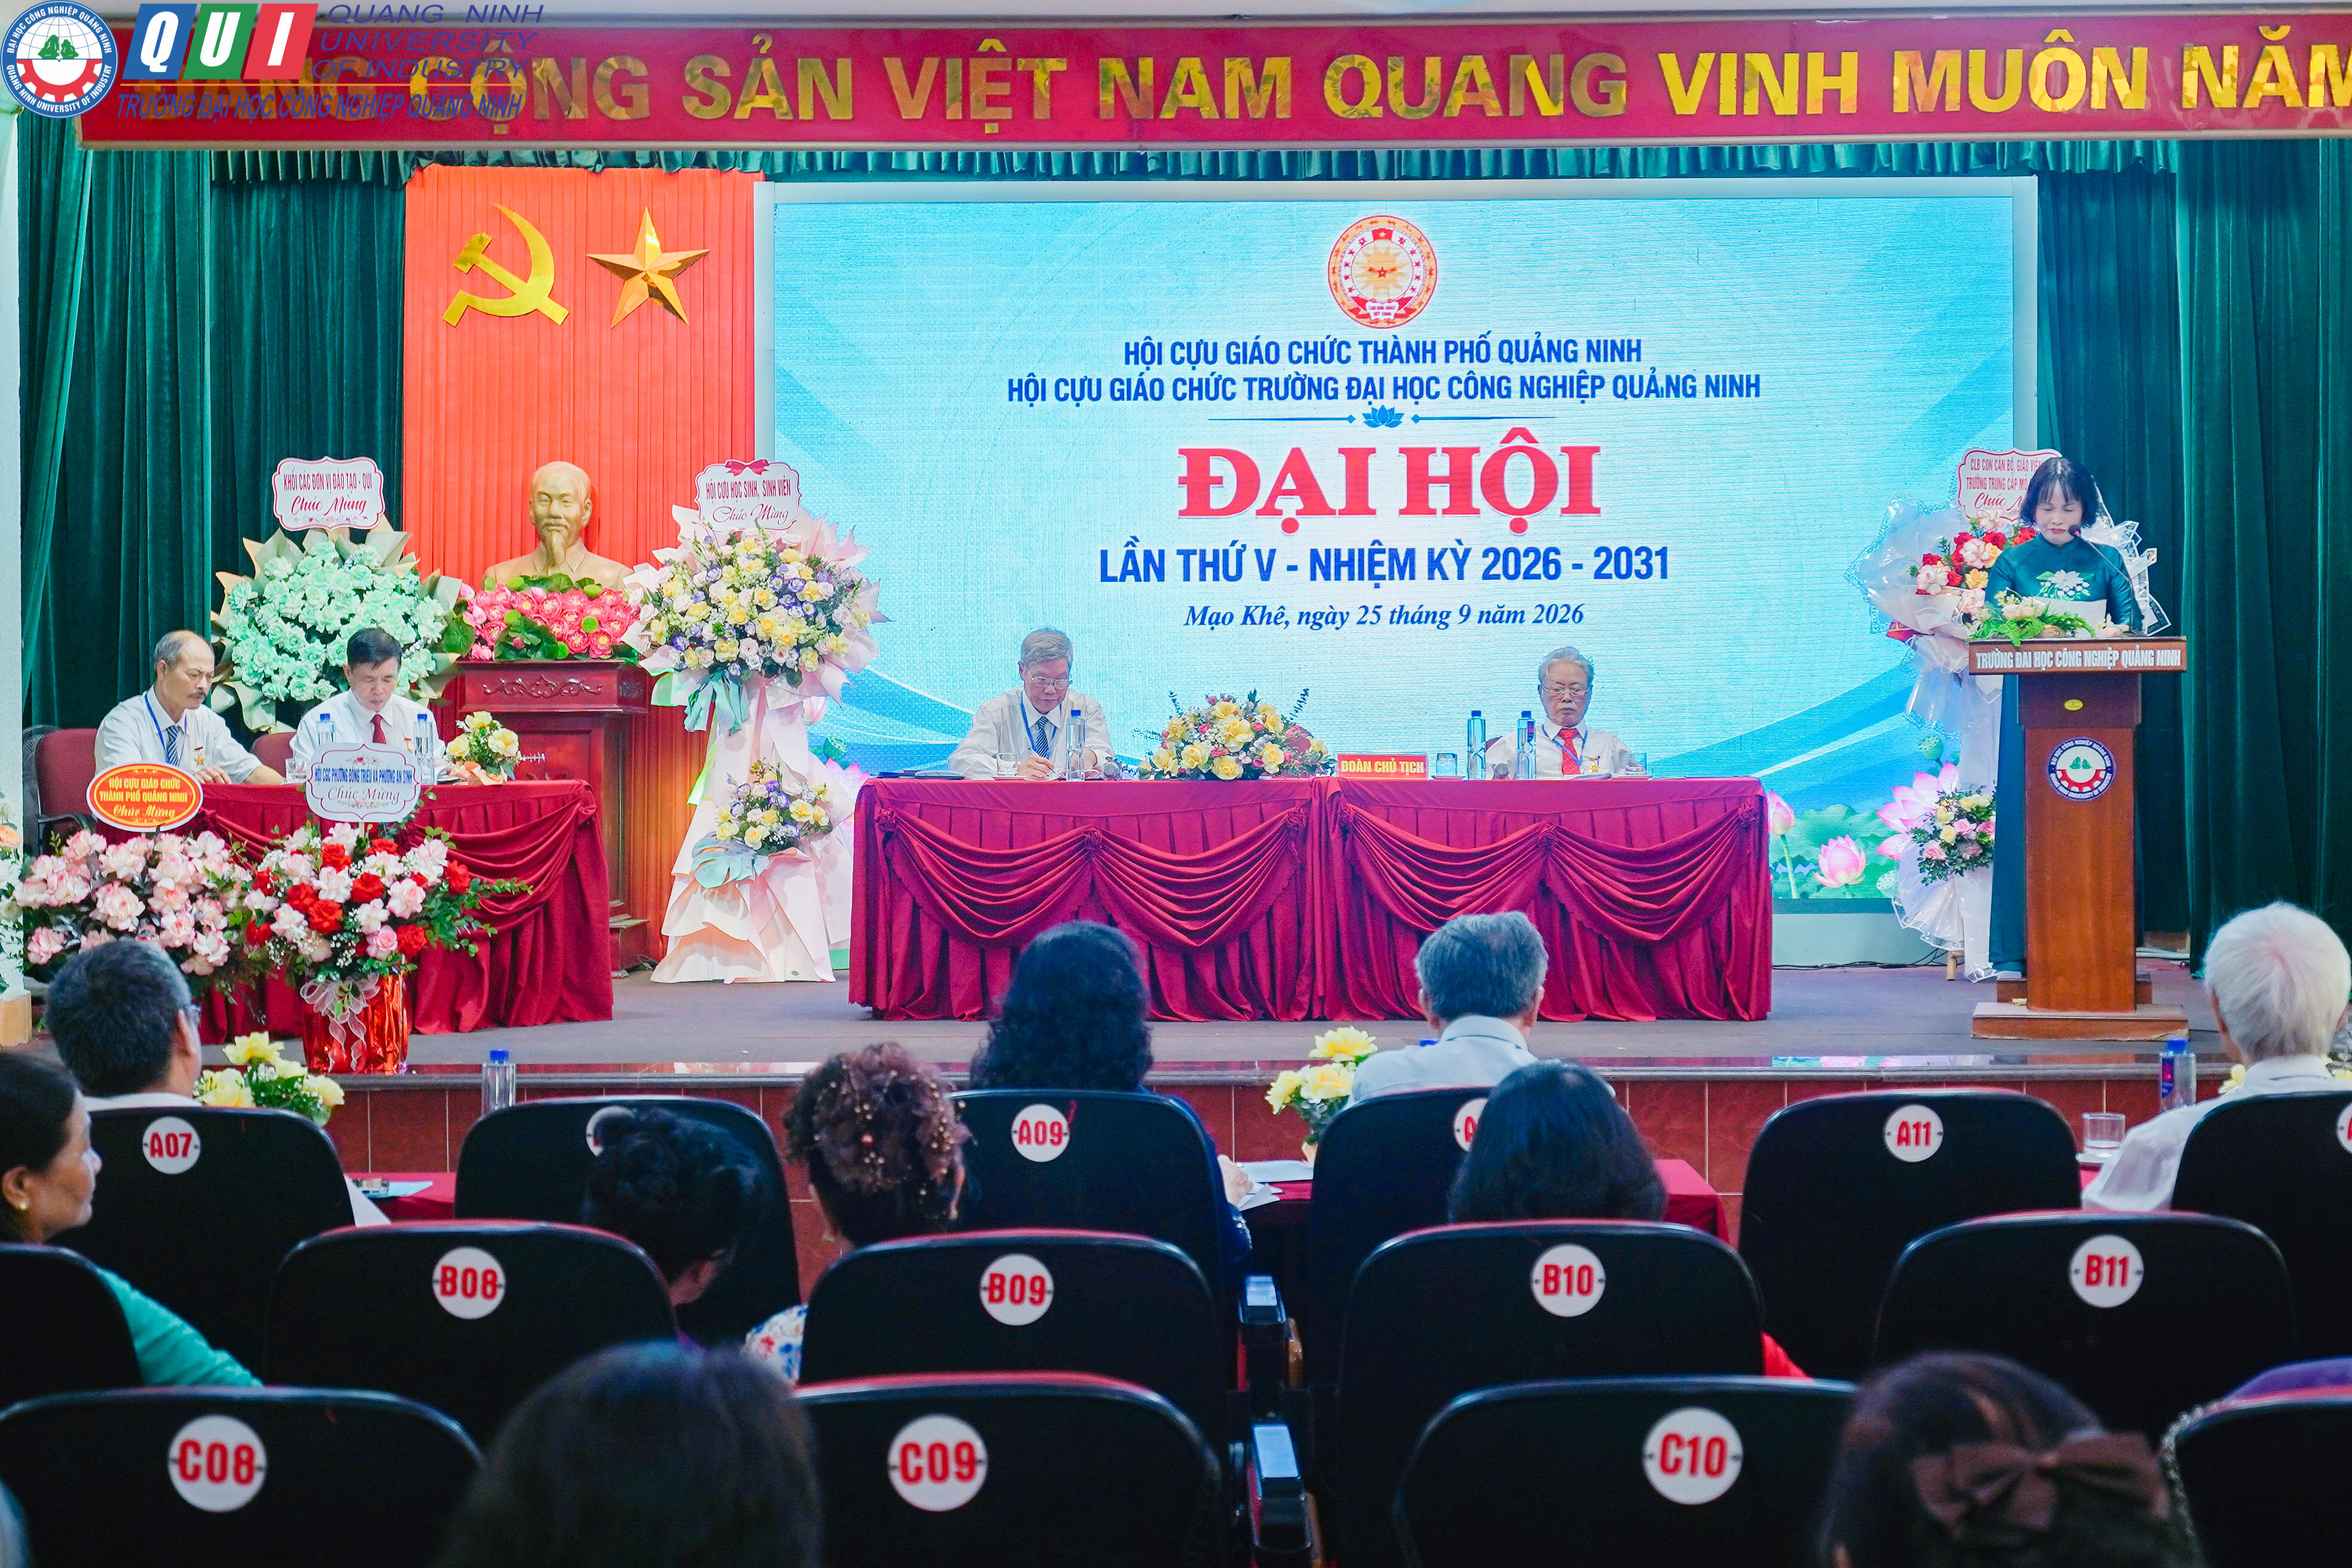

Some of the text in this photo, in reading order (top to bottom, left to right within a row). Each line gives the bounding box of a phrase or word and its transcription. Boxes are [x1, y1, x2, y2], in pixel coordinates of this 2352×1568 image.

[410, 39, 650, 134] CỘNG
[682, 33, 852, 120] SẢN
[883, 38, 1066, 133] VIỆT
[1099, 56, 1291, 119] NAM
[1324, 53, 1627, 118] QUANG
[1658, 52, 1857, 115] VINH
[1892, 29, 2147, 112] MUÔN
[1125, 330, 1642, 370] HỘI CỰU GIÁO CHỨC THÀNH PHỐ QUẢNG NINH
[1008, 367, 1760, 408] HỘI CỰU GIÁO CHỨC TRƯỜNG ĐẠI HỌC CÔNG NGHIỆP QUẢNG NINH
[1970, 458, 1980, 471] CLB
[1982, 459, 1993, 471] CON
[362, 473, 372, 491] QUI
[762, 479, 776, 497] SINH
[1177, 427, 1601, 535] ĐẠI HỘI
[1989, 477, 2005, 490] TRUNG
[291, 495, 323, 515] Chúc
[712, 506, 747, 523] Chúc
[1100, 535, 1166, 583] LẦN
[1176, 542, 1247, 582] THỨ
[1254, 548, 1276, 581] V
[1309, 539, 1416, 589] NHIỆM
[1426, 538, 1472, 581] KỲ
[1482, 546, 1561, 580] 2026
[1593, 546, 1669, 580] 2031
[1183, 603, 1584, 631] Mạo Khê, ngày 25 tháng 9 năm 2026
[1976, 648, 2014, 669] TRƯỜNG
[2034, 651, 2054, 672] HỌC
[2055, 647, 2082, 667] CÔNG
[2084, 647, 2120, 670] NGHIỆP
[2121, 644, 2154, 668] QUẢNG
[2156, 650, 2181, 666] NINH
[1341, 758, 1424, 776] ĐOÀN CHỦ TỊCH
[99, 789, 124, 802] THÀNH
[142, 790, 167, 803] QUẢNG
[169, 792, 188, 803] NINH
[109, 777, 122, 791] HỘI
[140, 777, 158, 789] GIÁO
[160, 777, 180, 790] CHỨC
[149, 1132, 192, 1158] A07
[1018, 1120, 1063, 1147] A09
[1897, 1120, 1931, 1147] A11
[440, 1266, 499, 1299] B08
[1544, 1264, 1594, 1296] B10
[2085, 1255, 2129, 1287] B11
[988, 1273, 1046, 1305] B09
[178, 1438, 256, 1486] C08
[898, 1441, 977, 1484] C09
[1659, 1432, 1727, 1478] C10
